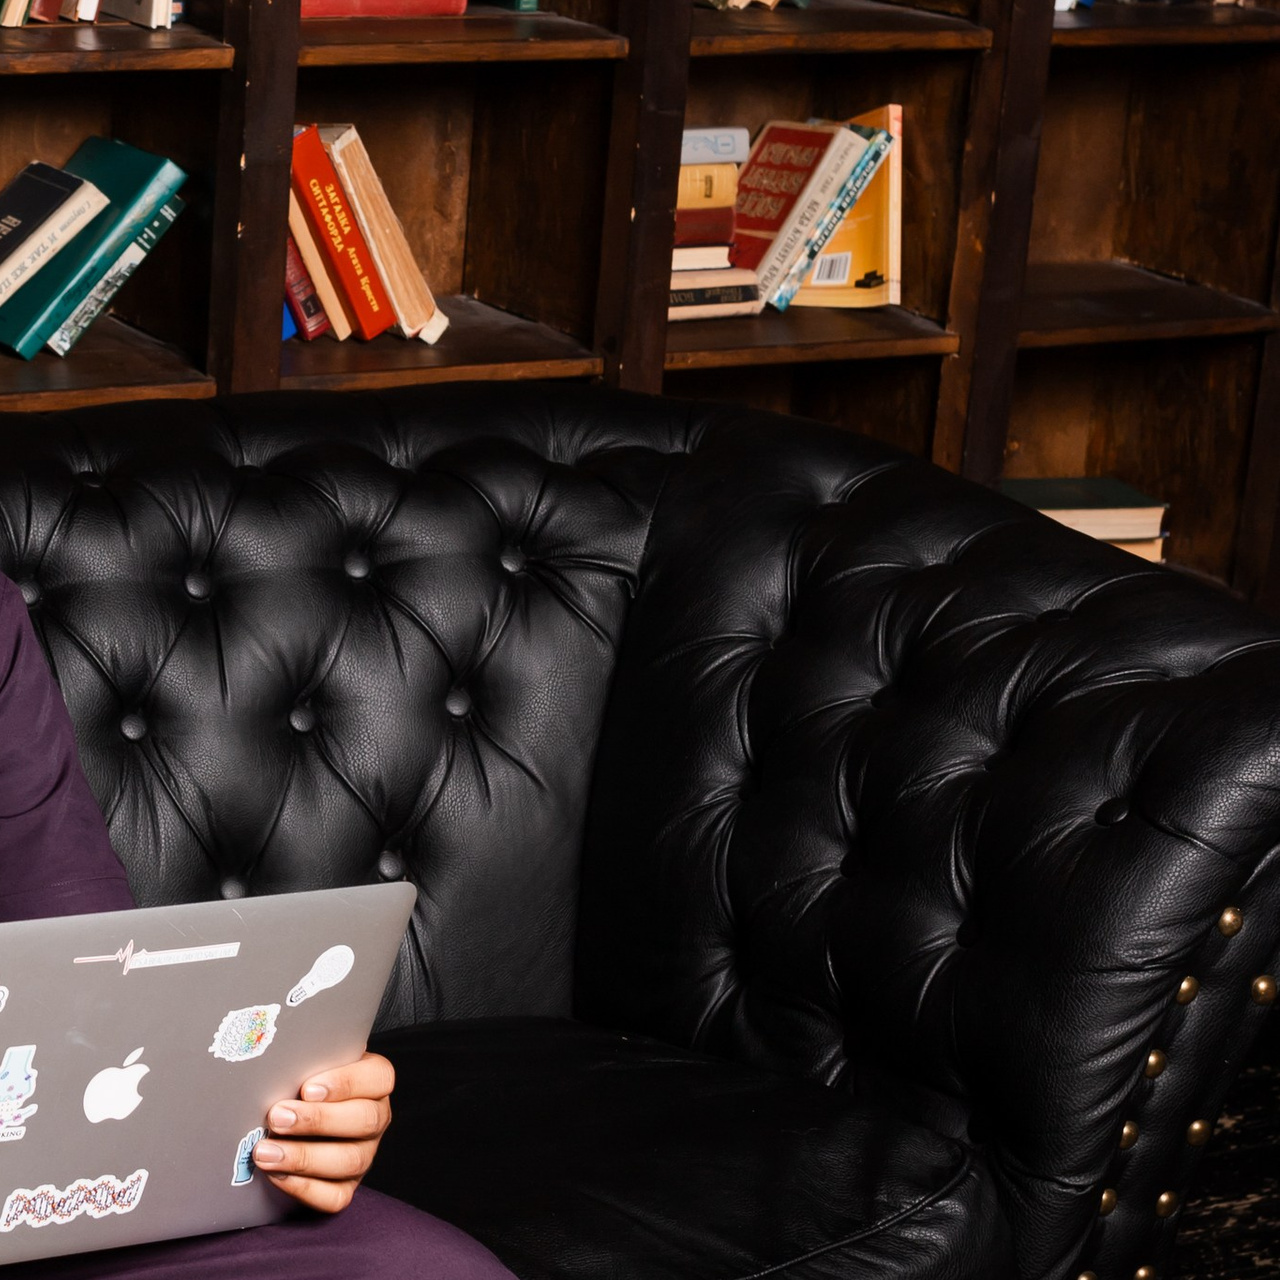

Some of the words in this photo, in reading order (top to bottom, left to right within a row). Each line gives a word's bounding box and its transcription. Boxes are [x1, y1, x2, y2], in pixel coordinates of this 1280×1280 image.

[307, 175, 346, 254] СИТТАФОРДА
[322, 181, 352, 236] ЗАГАДКА
[794, 196, 822, 231] КОГДА
[8, 259, 30, 282] ЖЕ
[24, 240, 50, 266] ТАК
[345, 243, 366, 276] Агата
[357, 273, 382, 313] Кристи
